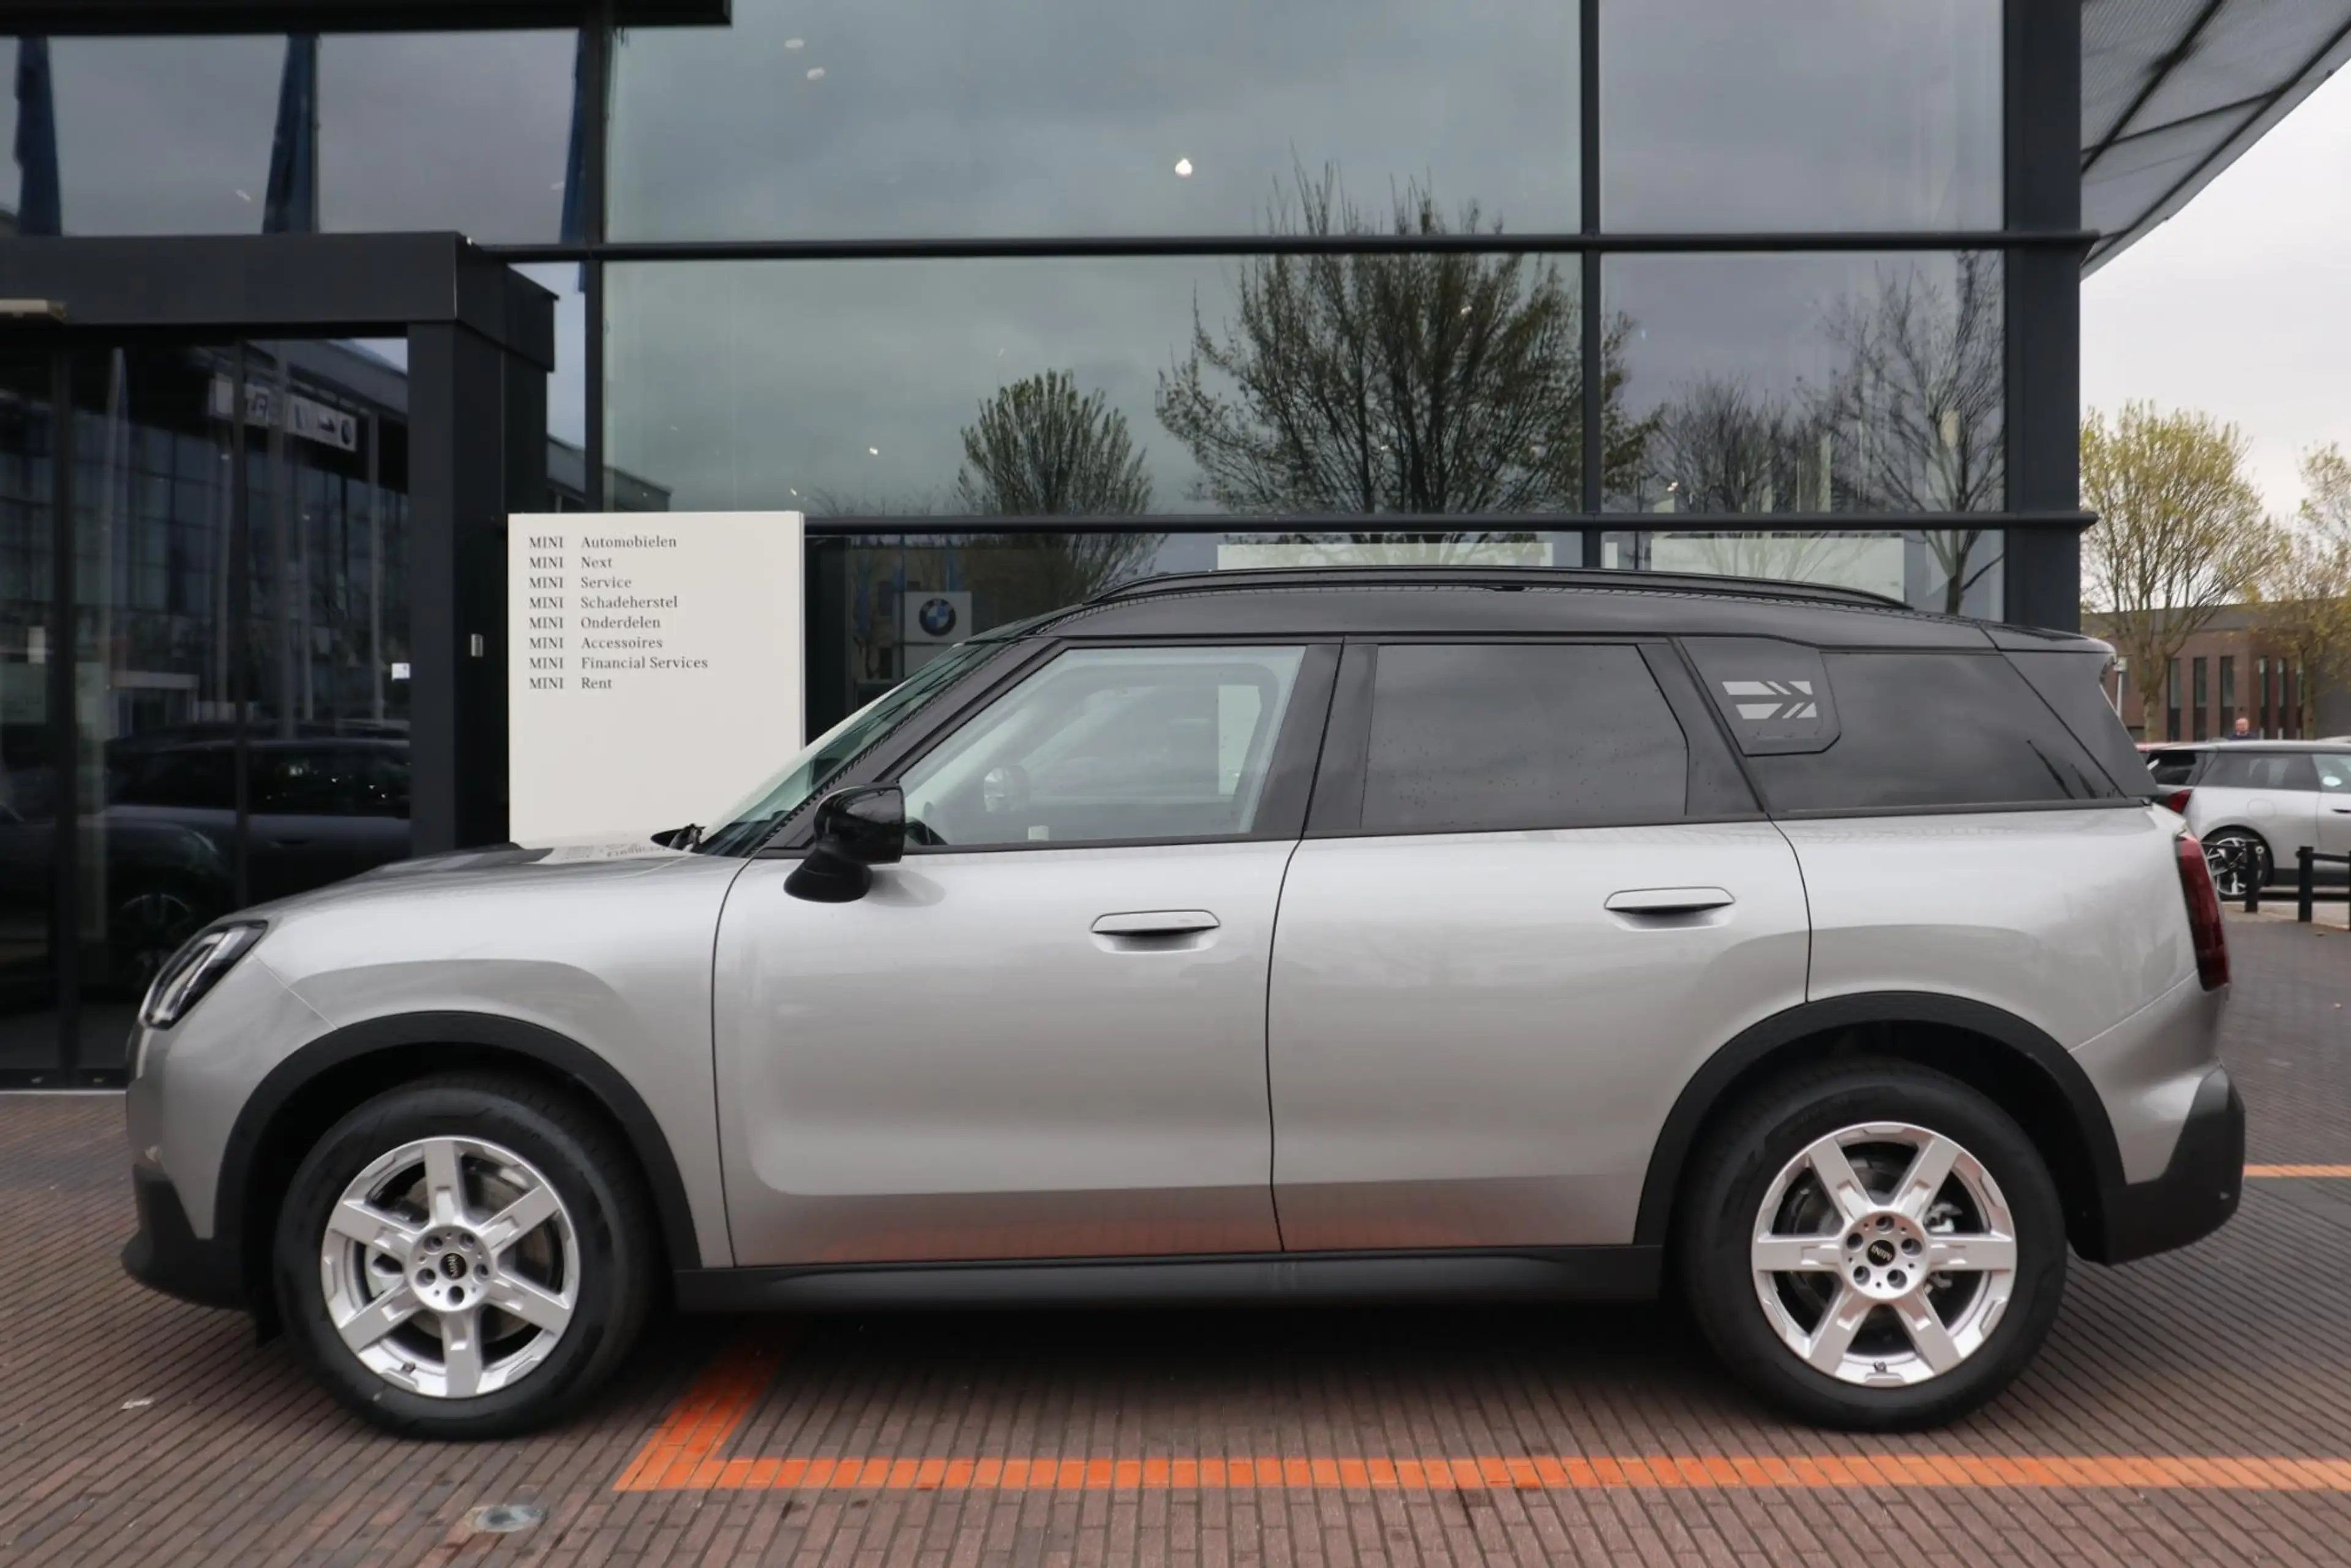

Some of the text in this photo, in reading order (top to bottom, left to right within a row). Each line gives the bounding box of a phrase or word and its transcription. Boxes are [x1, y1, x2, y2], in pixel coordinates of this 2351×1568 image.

[530, 535, 677, 549] MINI Automobielen
[530, 557, 612, 569] MINI Next
[529, 577, 632, 589] MINI Service
[530, 595, 678, 609] MINI Schadeherstel
[530, 615, 661, 629] MINI Onderdelen
[530, 637, 663, 650] MINI Accessoires
[530, 656, 708, 669] MINI Financial Services
[530, 677, 612, 689] MINI Rent
